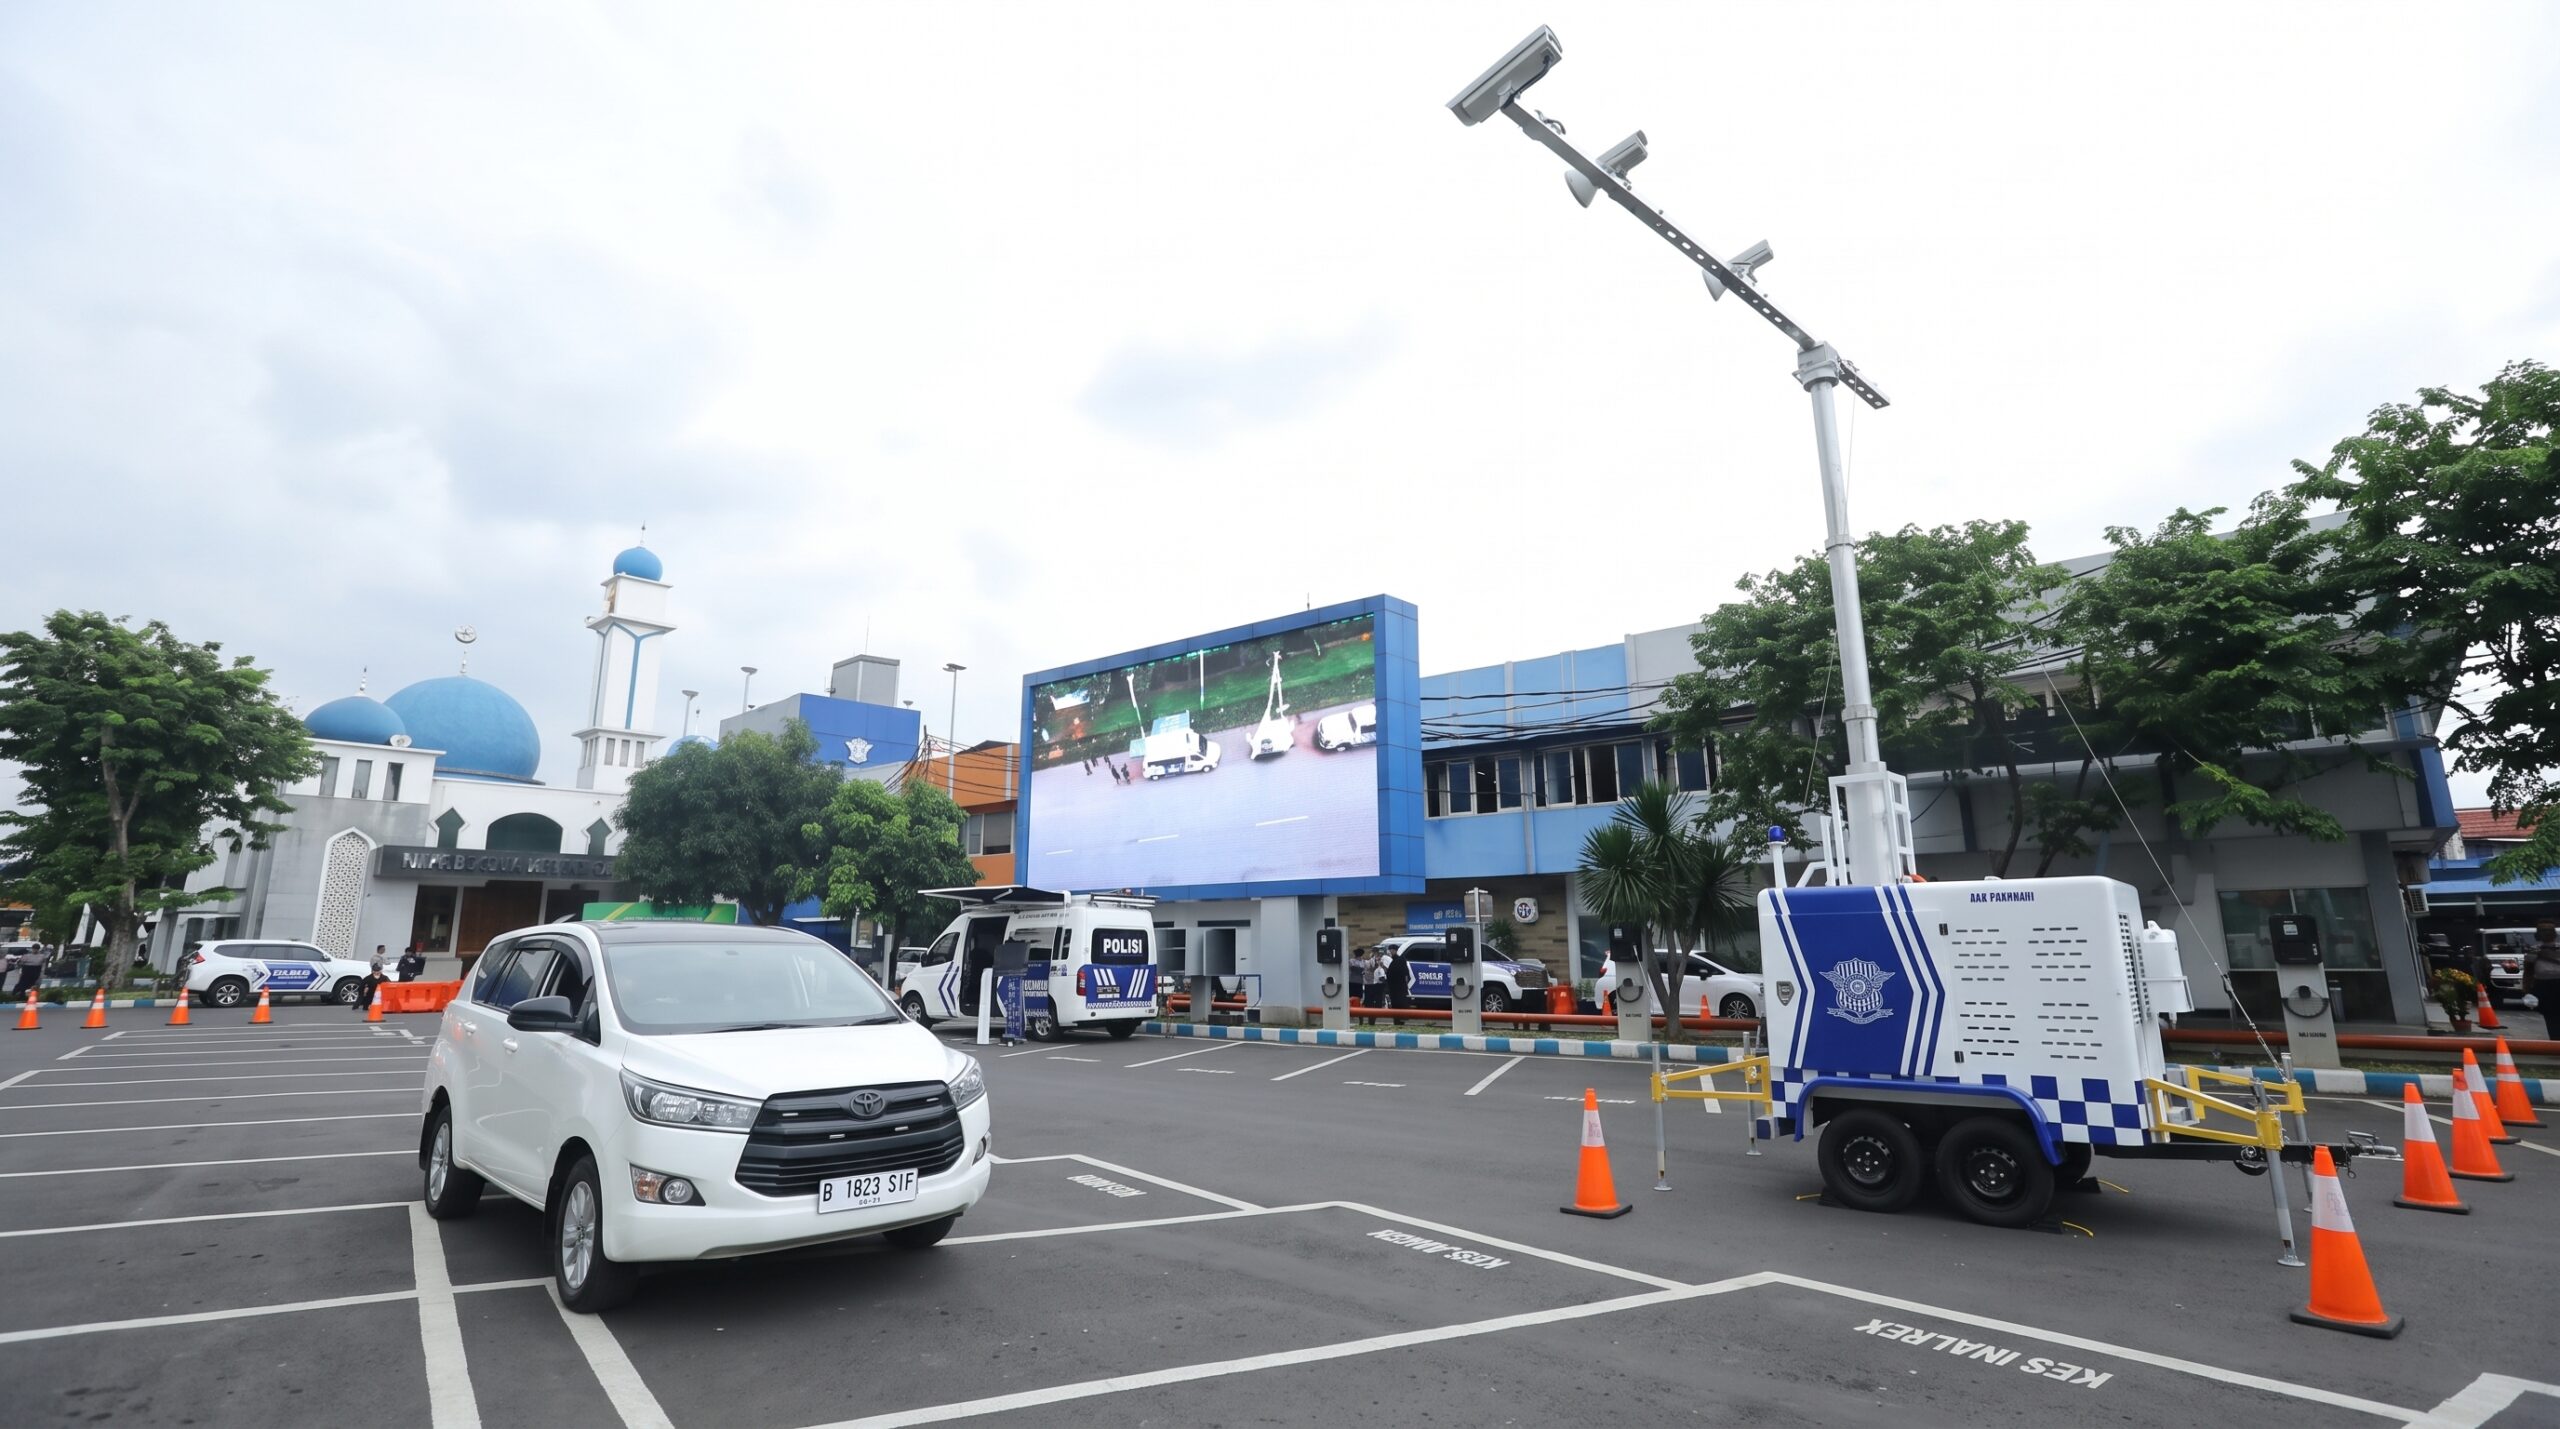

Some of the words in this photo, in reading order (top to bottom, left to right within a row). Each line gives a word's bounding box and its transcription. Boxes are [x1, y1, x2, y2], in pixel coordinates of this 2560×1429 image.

[1103, 938, 1143, 954] POLISI
[822, 1182, 833, 1202] B
[846, 1176, 881, 1199] 1823
[888, 1172, 914, 1193] SIF
[1852, 1318, 2021, 1366] INALREX
[2019, 1357, 2114, 1389] KES
